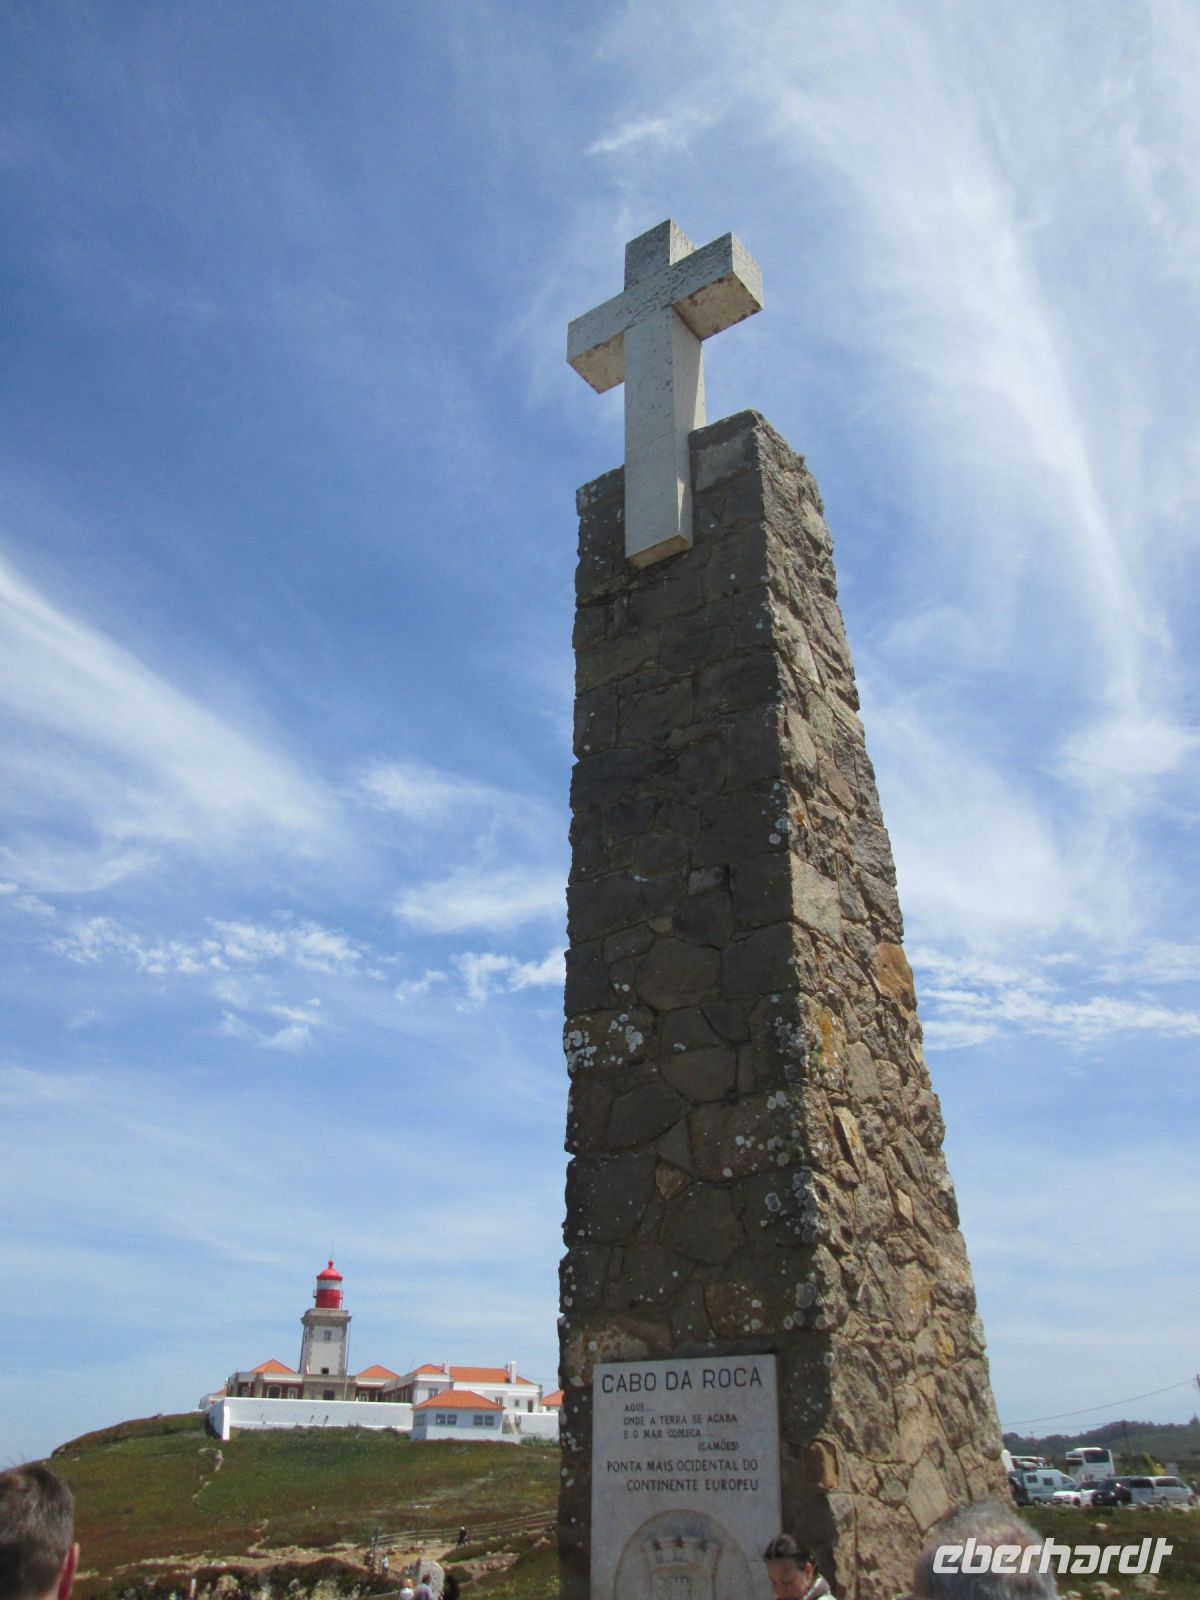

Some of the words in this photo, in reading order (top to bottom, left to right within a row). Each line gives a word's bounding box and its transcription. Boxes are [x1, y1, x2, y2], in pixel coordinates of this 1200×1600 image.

[602, 1372, 657, 1393] CABO
[665, 1370, 693, 1391] DA
[702, 1366, 763, 1389] ROCA
[623, 1415, 645, 1426] ONDE
[650, 1415, 656, 1425] A
[660, 1414, 687, 1425] TERRA
[692, 1413, 702, 1424] SE
[707, 1413, 738, 1424] ACABA
[624, 1430, 629, 1440] E
[633, 1430, 639, 1439] O
[643, 1429, 663, 1439] MAR
[607, 1460, 642, 1473] PONTA
[646, 1459, 673, 1472] MAIS
[676, 1458, 739, 1472] OCIDENTAL
[743, 1458, 758, 1471] DO
[626, 1479, 699, 1492] CONTINENTE
[705, 1478, 759, 1492] EUROPEU
